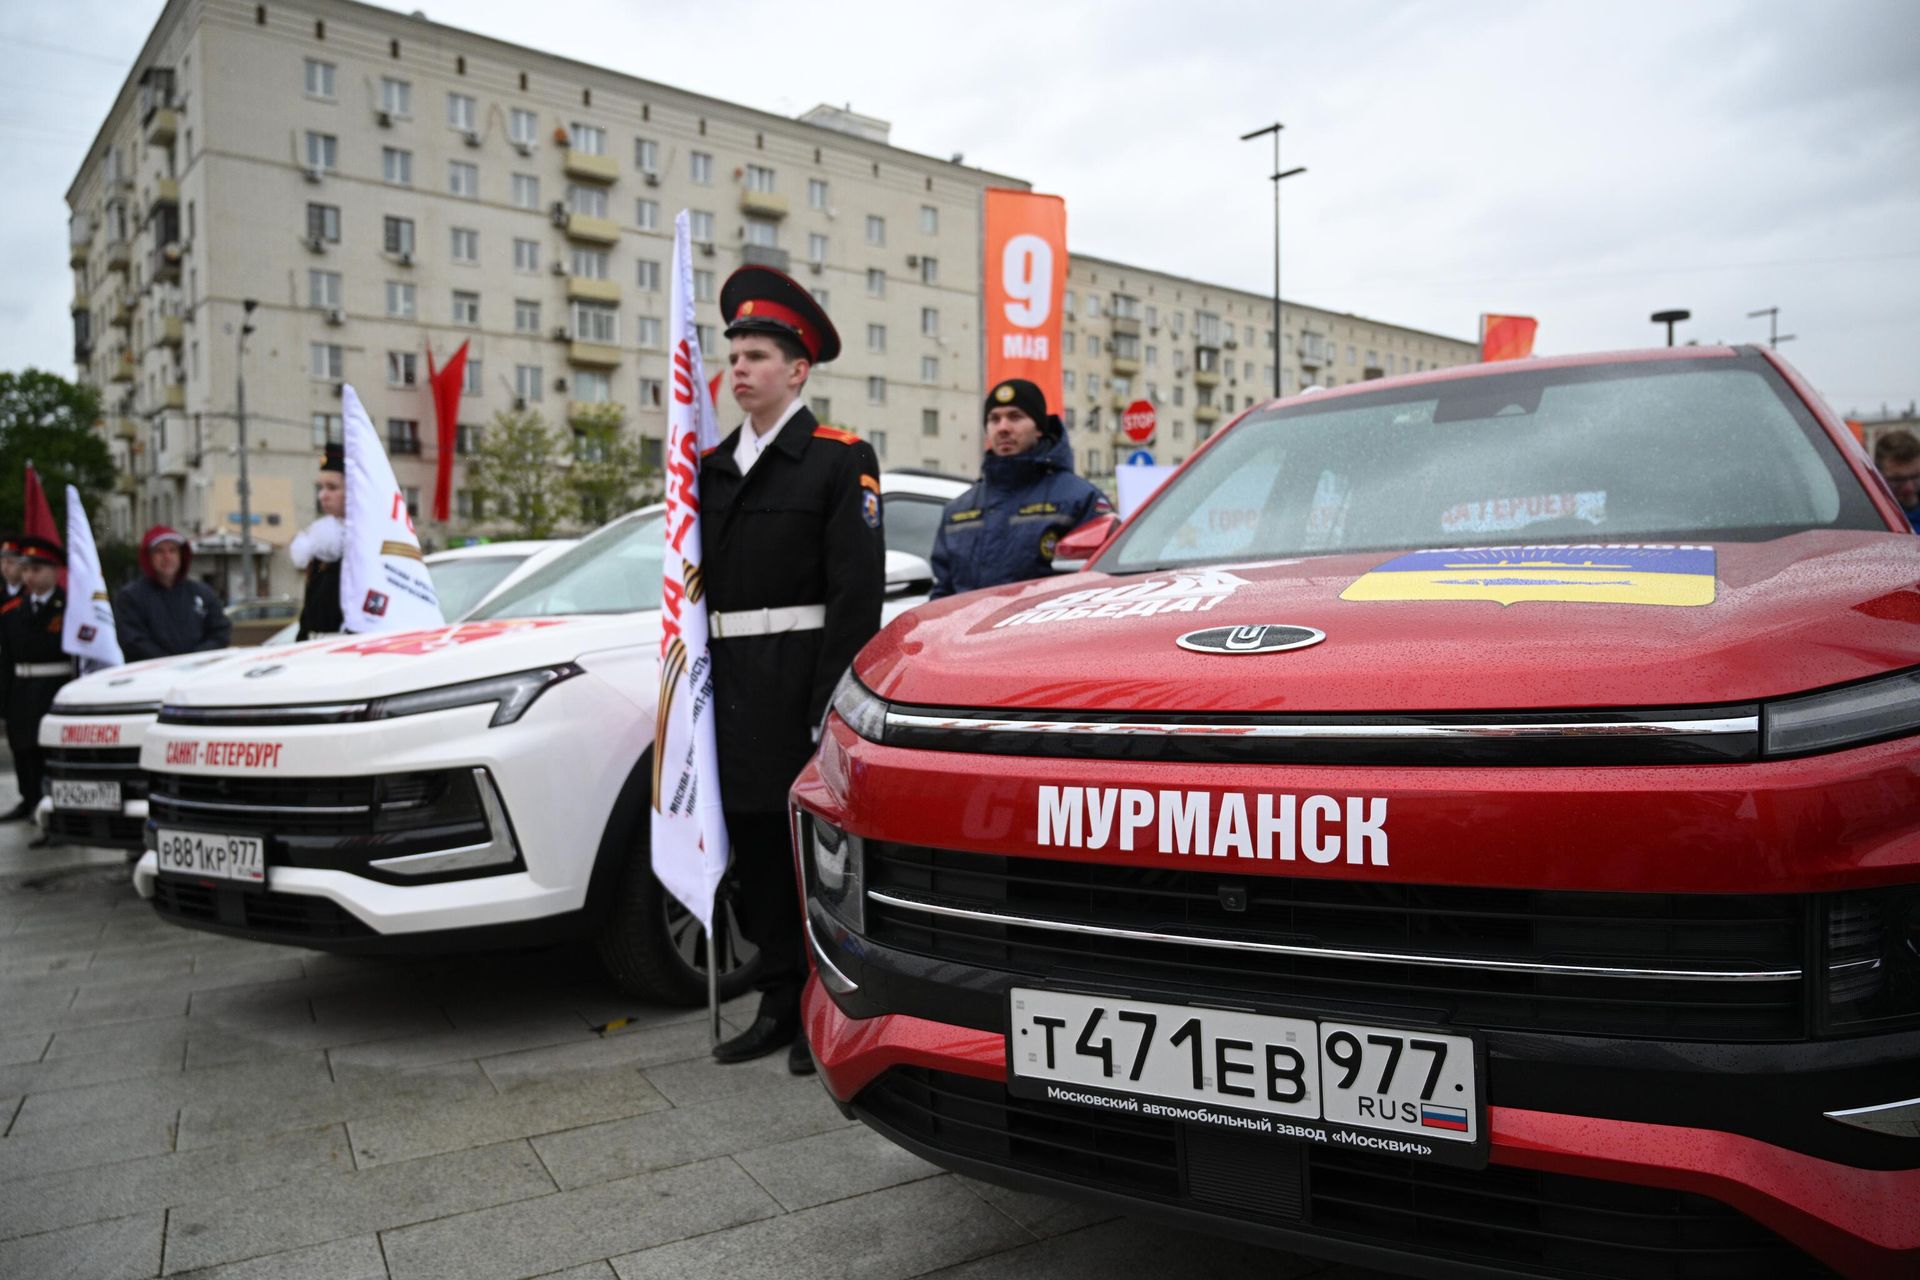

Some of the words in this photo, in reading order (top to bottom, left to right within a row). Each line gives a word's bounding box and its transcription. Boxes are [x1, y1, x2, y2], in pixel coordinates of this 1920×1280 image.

[1002, 235, 1053, 328] 9
[1003, 334, 1048, 360] МАЯ
[1123, 413, 1154, 430] STOP
[993, 595, 1228, 629] ПОБЕДА!
[60, 724, 120, 745] СМОЛЕНСК
[1037, 785, 1390, 867] МУРМАНСК
[229, 840, 257, 867] 977
[1033, 1008, 1307, 1104] Т471ЕВ
[1325, 1030, 1448, 1101] 977
[1047, 1085, 1139, 1112] Московский
[1142, 1102, 1273, 1132] автомобильный
[1276, 1123, 1327, 1143] завод
[1331, 1131, 1433, 1156] «Москвич»
[1358, 1095, 1418, 1124] RUS
